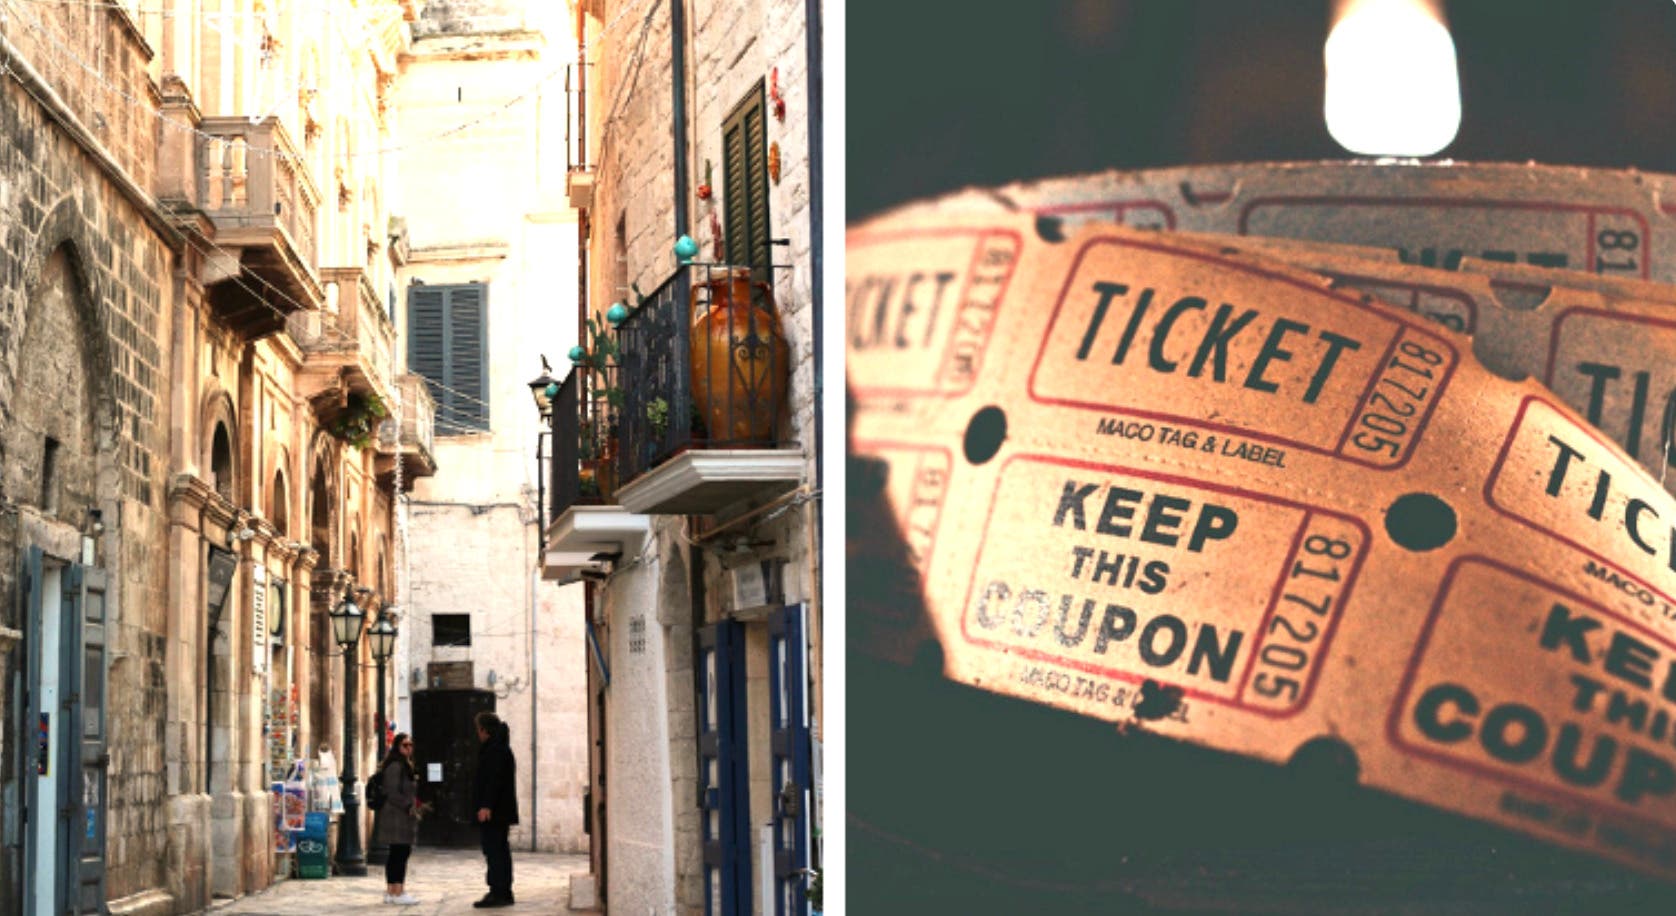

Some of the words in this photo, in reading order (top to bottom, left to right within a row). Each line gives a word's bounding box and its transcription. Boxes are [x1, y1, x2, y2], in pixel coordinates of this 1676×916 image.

[846, 271, 957, 350] CKET
[1076, 281, 1361, 404] TICKET
[1096, 417, 1155, 442] MACO
[1158, 427, 1199, 449] TAG
[1202, 436, 1217, 453] &
[1221, 439, 1286, 468] LABEL
[1353, 340, 1444, 458] 817205
[1052, 480, 1239, 553] KEEP
[1545, 434, 1676, 573] TIC
[1070, 546, 1170, 595] THIS
[1253, 535, 1352, 702] 817205
[1583, 561, 1655, 606] MACO
[976, 580, 1244, 684] COUPON
[1539, 602, 1676, 703] KE
[1414, 682, 1676, 804] COUP
[1570, 673, 1676, 748] THI
